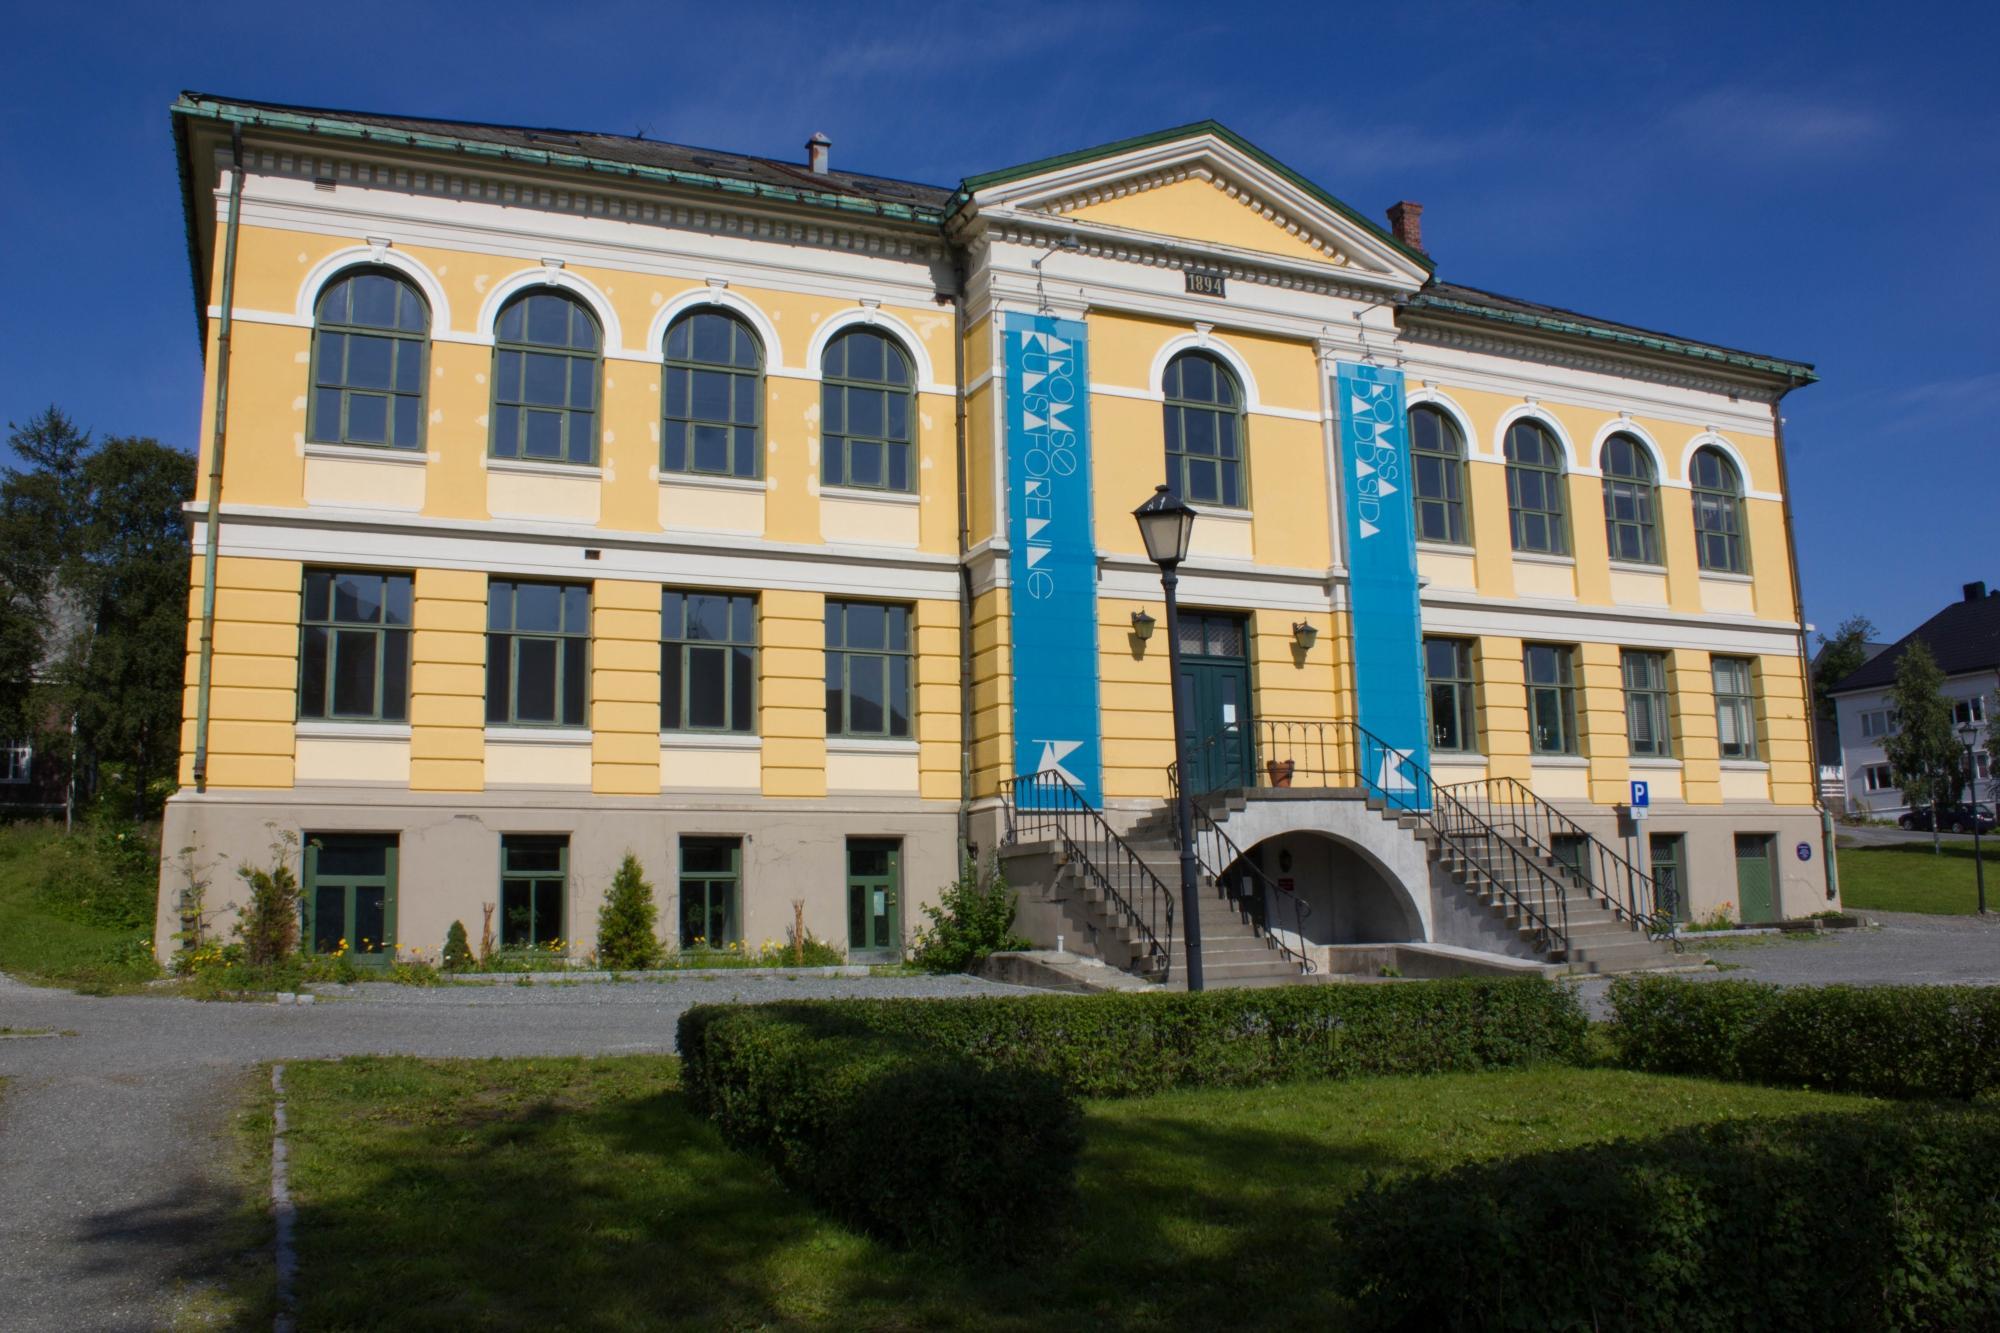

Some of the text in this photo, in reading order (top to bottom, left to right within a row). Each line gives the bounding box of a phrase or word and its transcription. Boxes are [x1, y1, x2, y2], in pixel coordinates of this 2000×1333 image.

[1188, 273, 1222, 295] 1894
[1048, 334, 1077, 476] TROMSØ
[1372, 383, 1399, 498] ROMSSA
[1021, 330, 1054, 600] KUNSTFORENING
[1634, 783, 1645, 804] P
